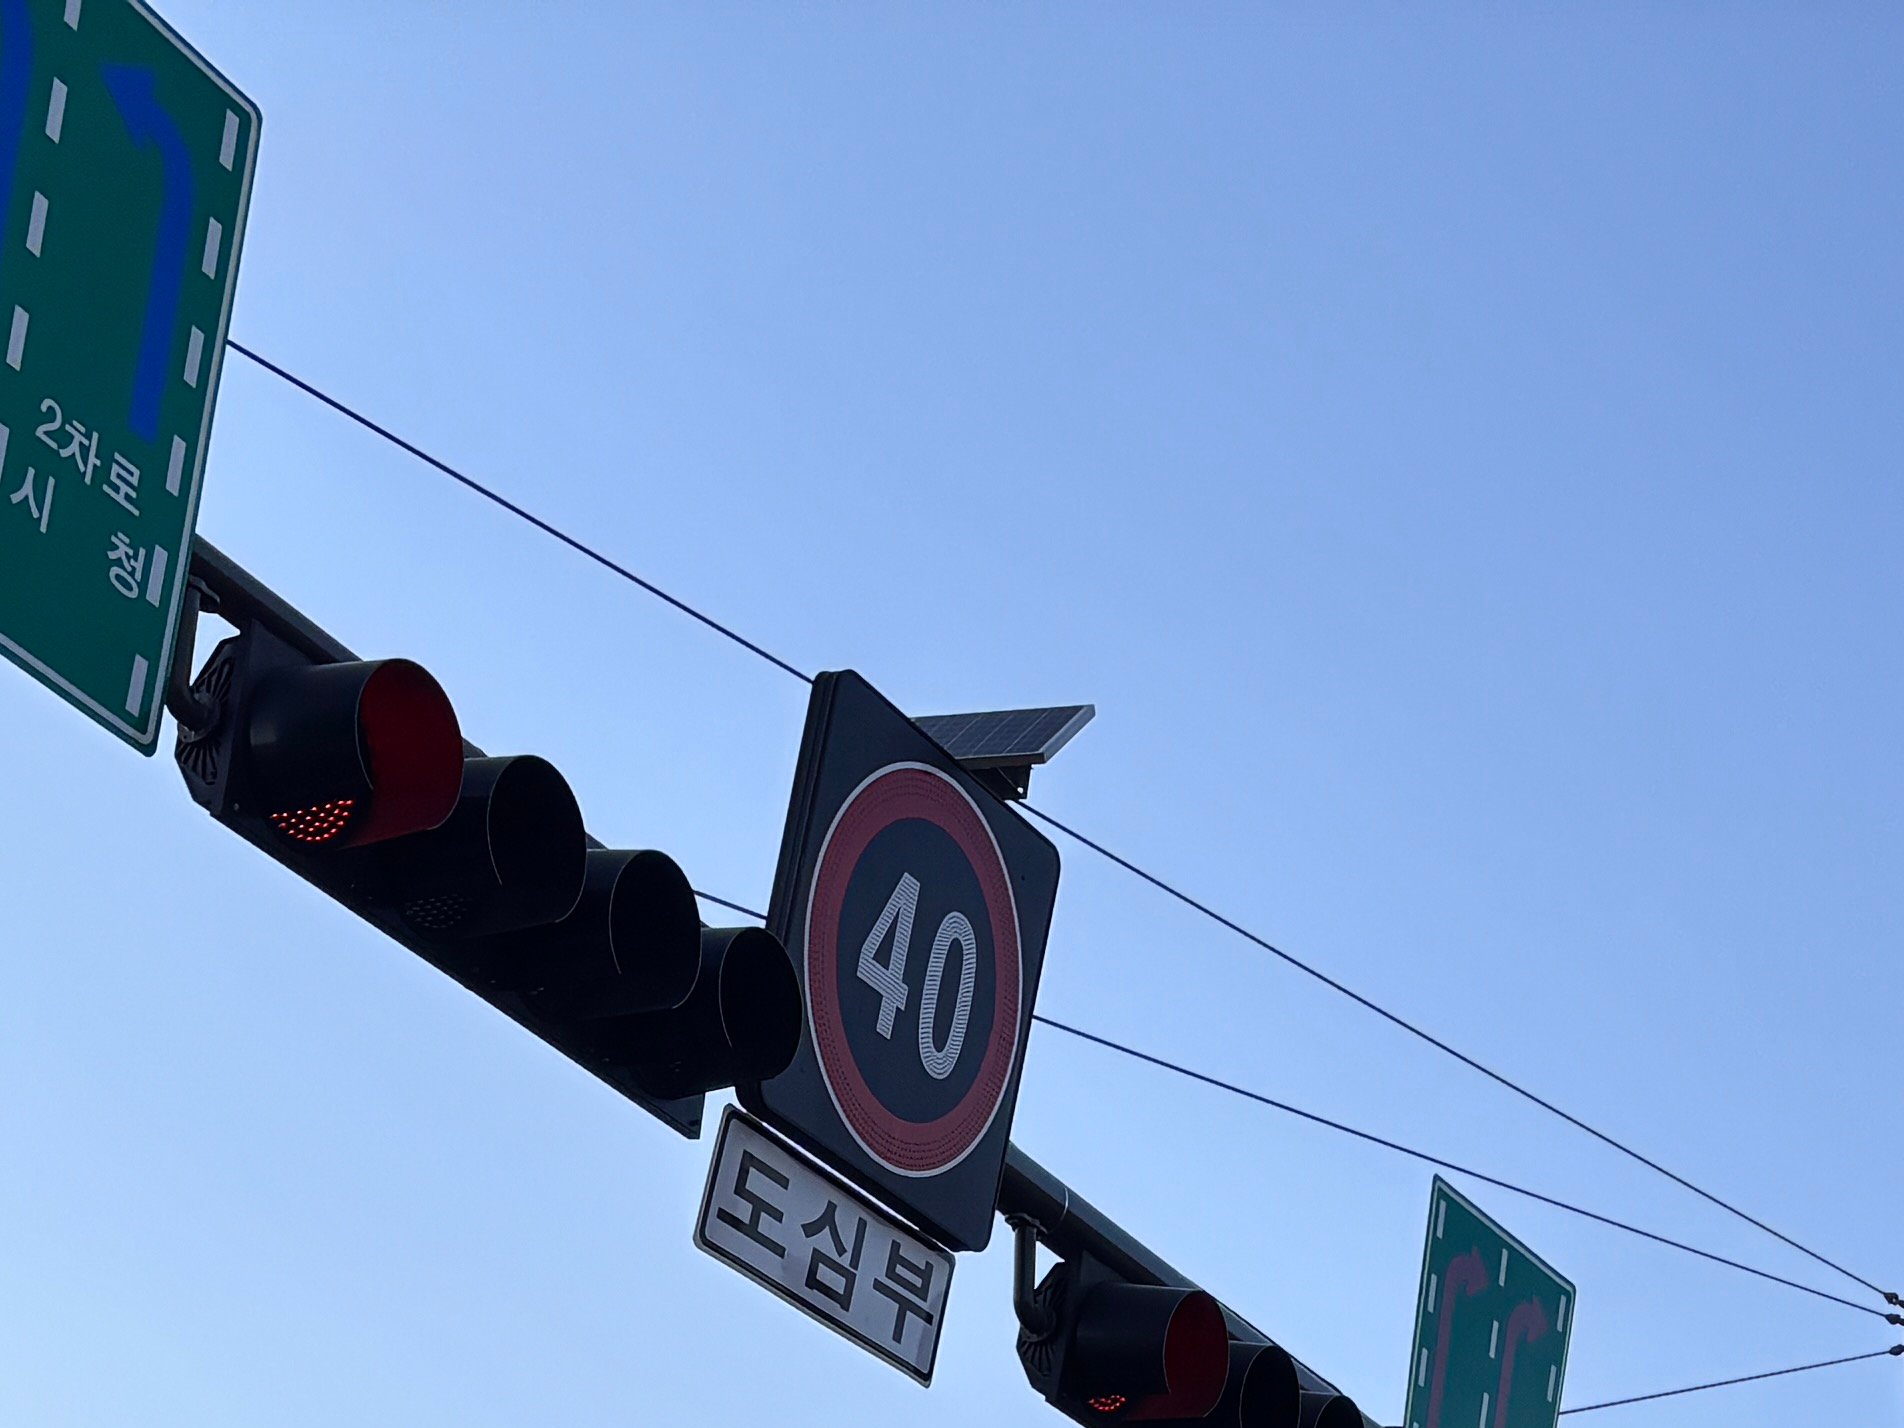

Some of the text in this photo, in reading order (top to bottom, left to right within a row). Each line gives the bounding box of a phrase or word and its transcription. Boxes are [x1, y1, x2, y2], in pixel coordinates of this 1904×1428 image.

[34, 398, 142, 517] 2차로
[856, 872, 978, 1080] 40
[717, 1148, 935, 1345] 도심부
